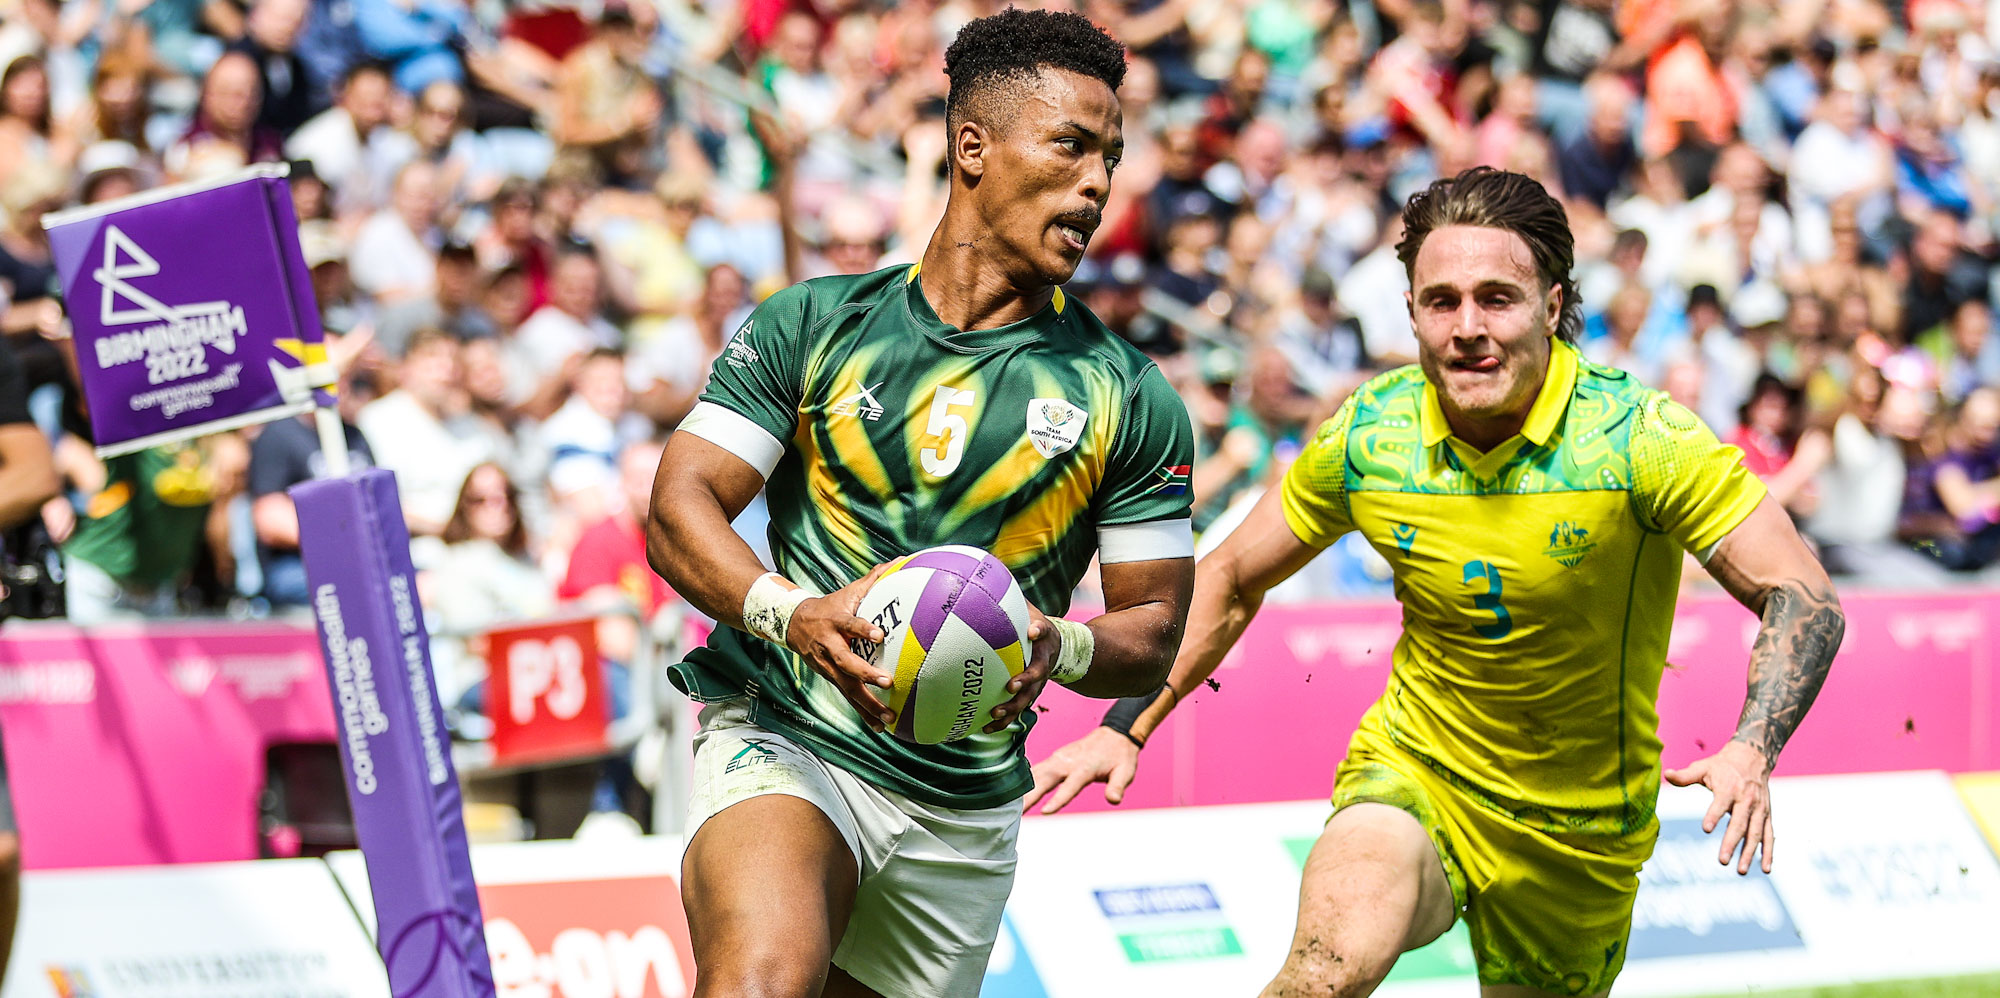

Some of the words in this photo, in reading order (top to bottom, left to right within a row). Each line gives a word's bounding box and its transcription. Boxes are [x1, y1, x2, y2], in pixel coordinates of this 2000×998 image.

[95, 305, 248, 369] BIRMINGHAM
[145, 345, 210, 385] 2022
[832, 402, 885, 422] ELITE
[920, 384, 976, 477] 5
[1031, 429, 1051, 439] SOUTH
[1051, 434, 1073, 445] AFRICA
[1046, 426, 1061, 435] TEAM
[389, 573, 418, 635] 2022
[1463, 559, 1513, 640] 3
[315, 583, 377, 795] commonwealth
[348, 636, 389, 736] games
[507, 635, 587, 725] P3
[961, 656, 984, 697] 2022
[403, 635, 448, 785] BIRMINGHAM
[725, 755, 778, 775] ELITE
